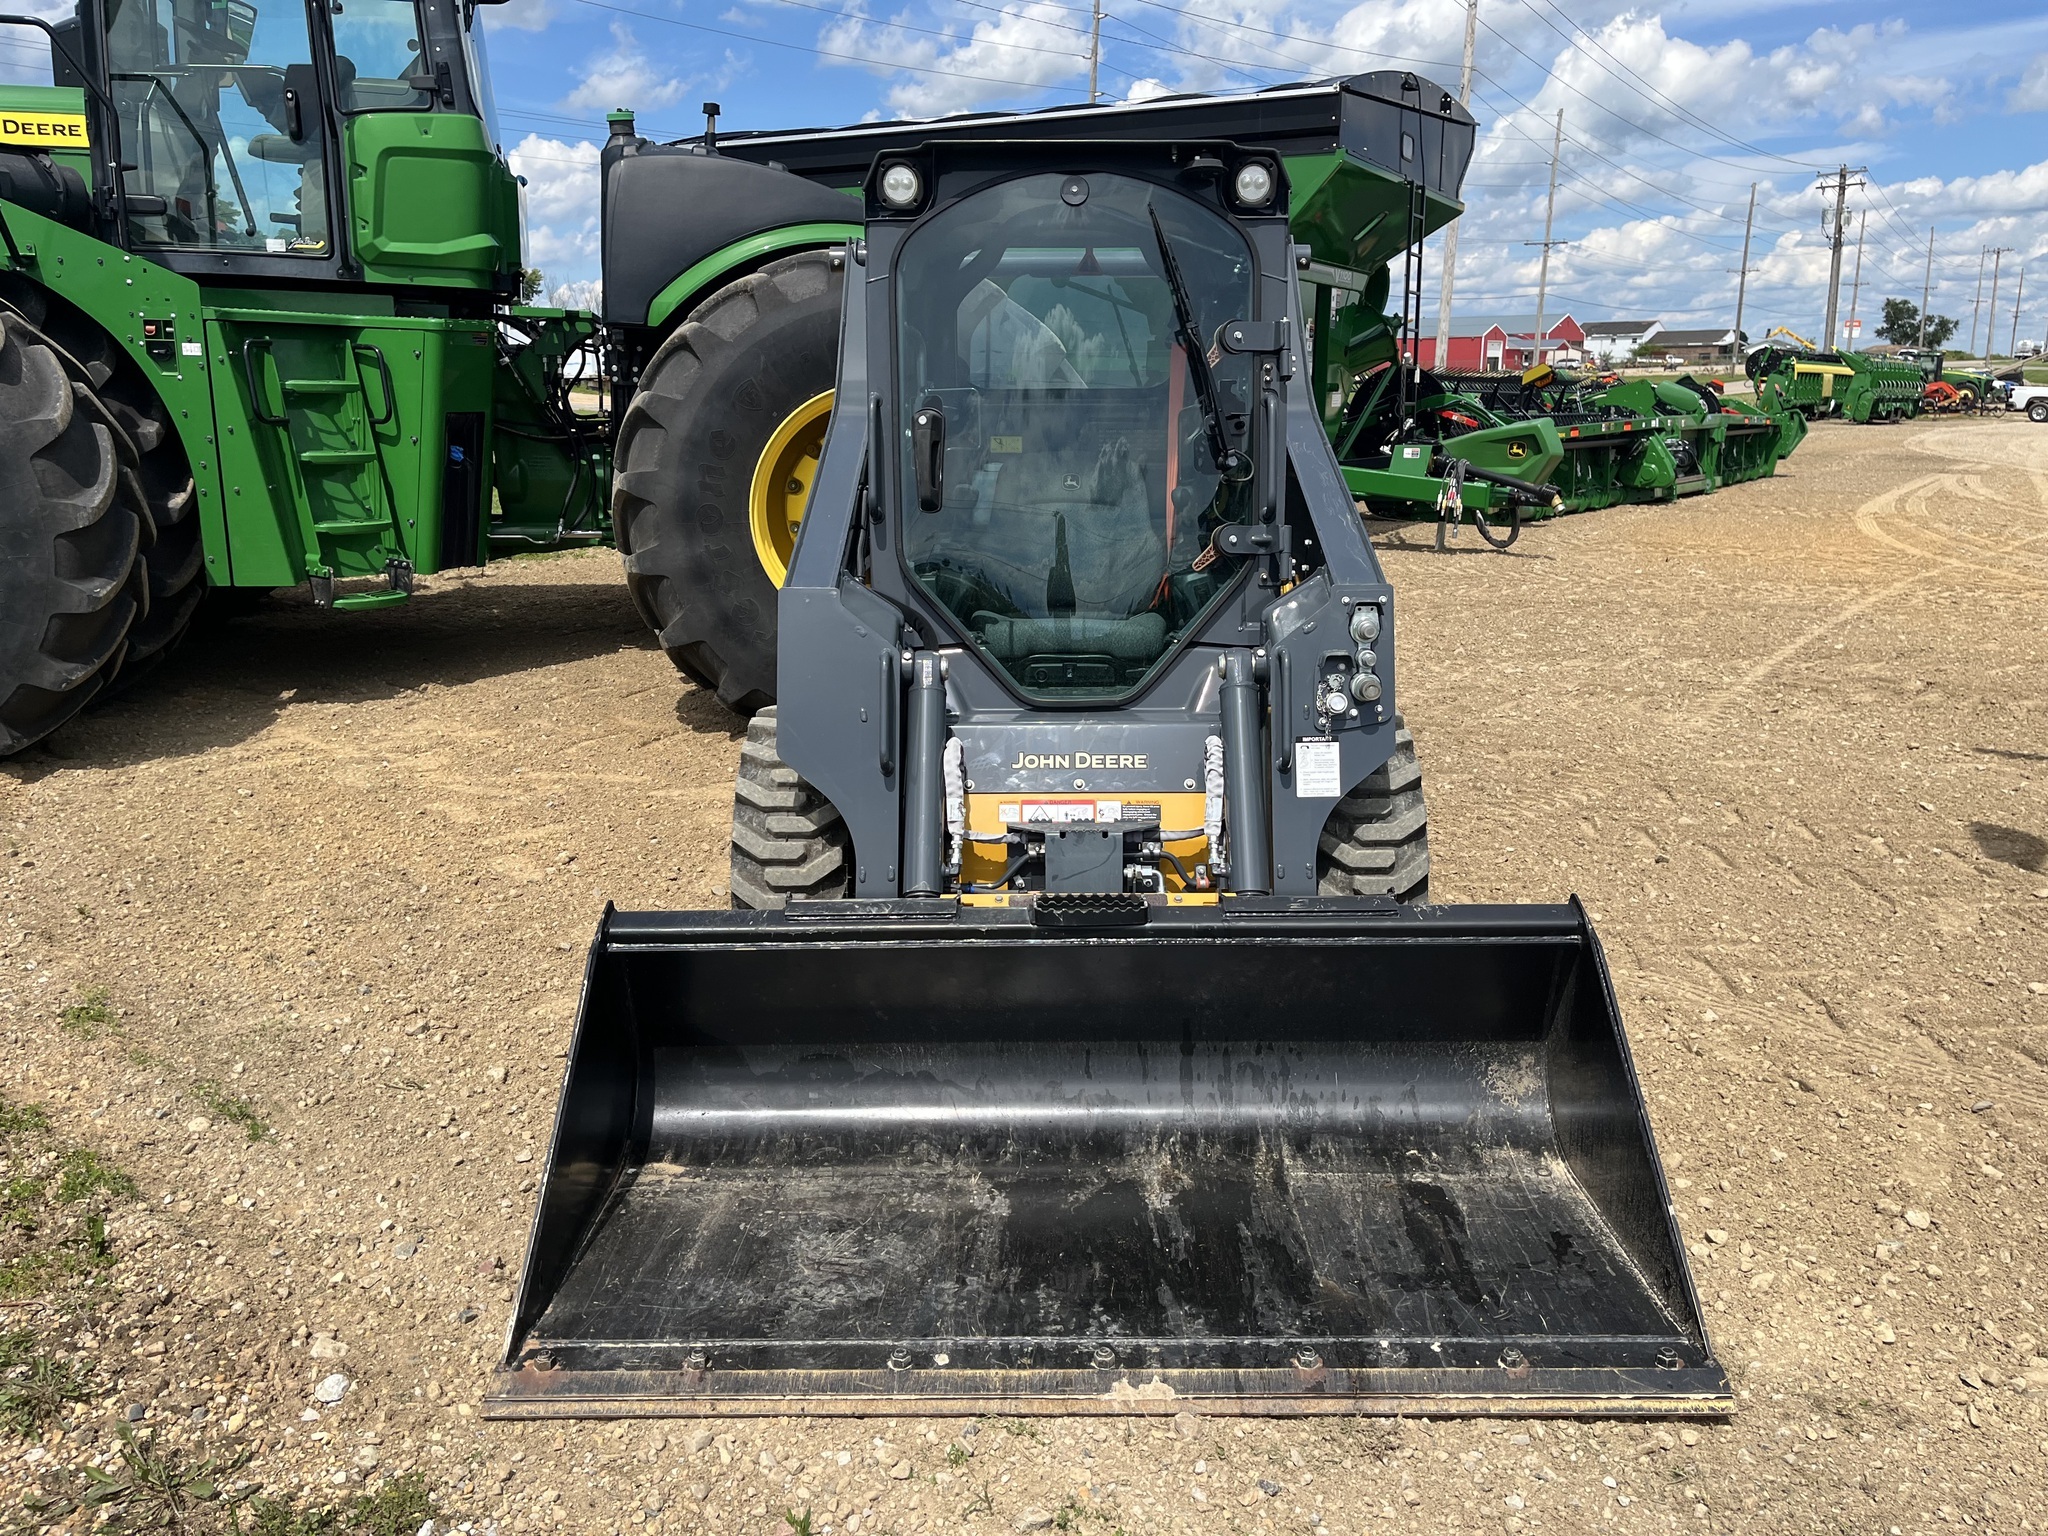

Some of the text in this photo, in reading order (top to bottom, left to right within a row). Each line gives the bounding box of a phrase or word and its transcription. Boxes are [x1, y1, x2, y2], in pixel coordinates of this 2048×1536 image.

[2, 119, 82, 136] DEERE
[1011, 752, 1148, 769] JOHN DEERE
